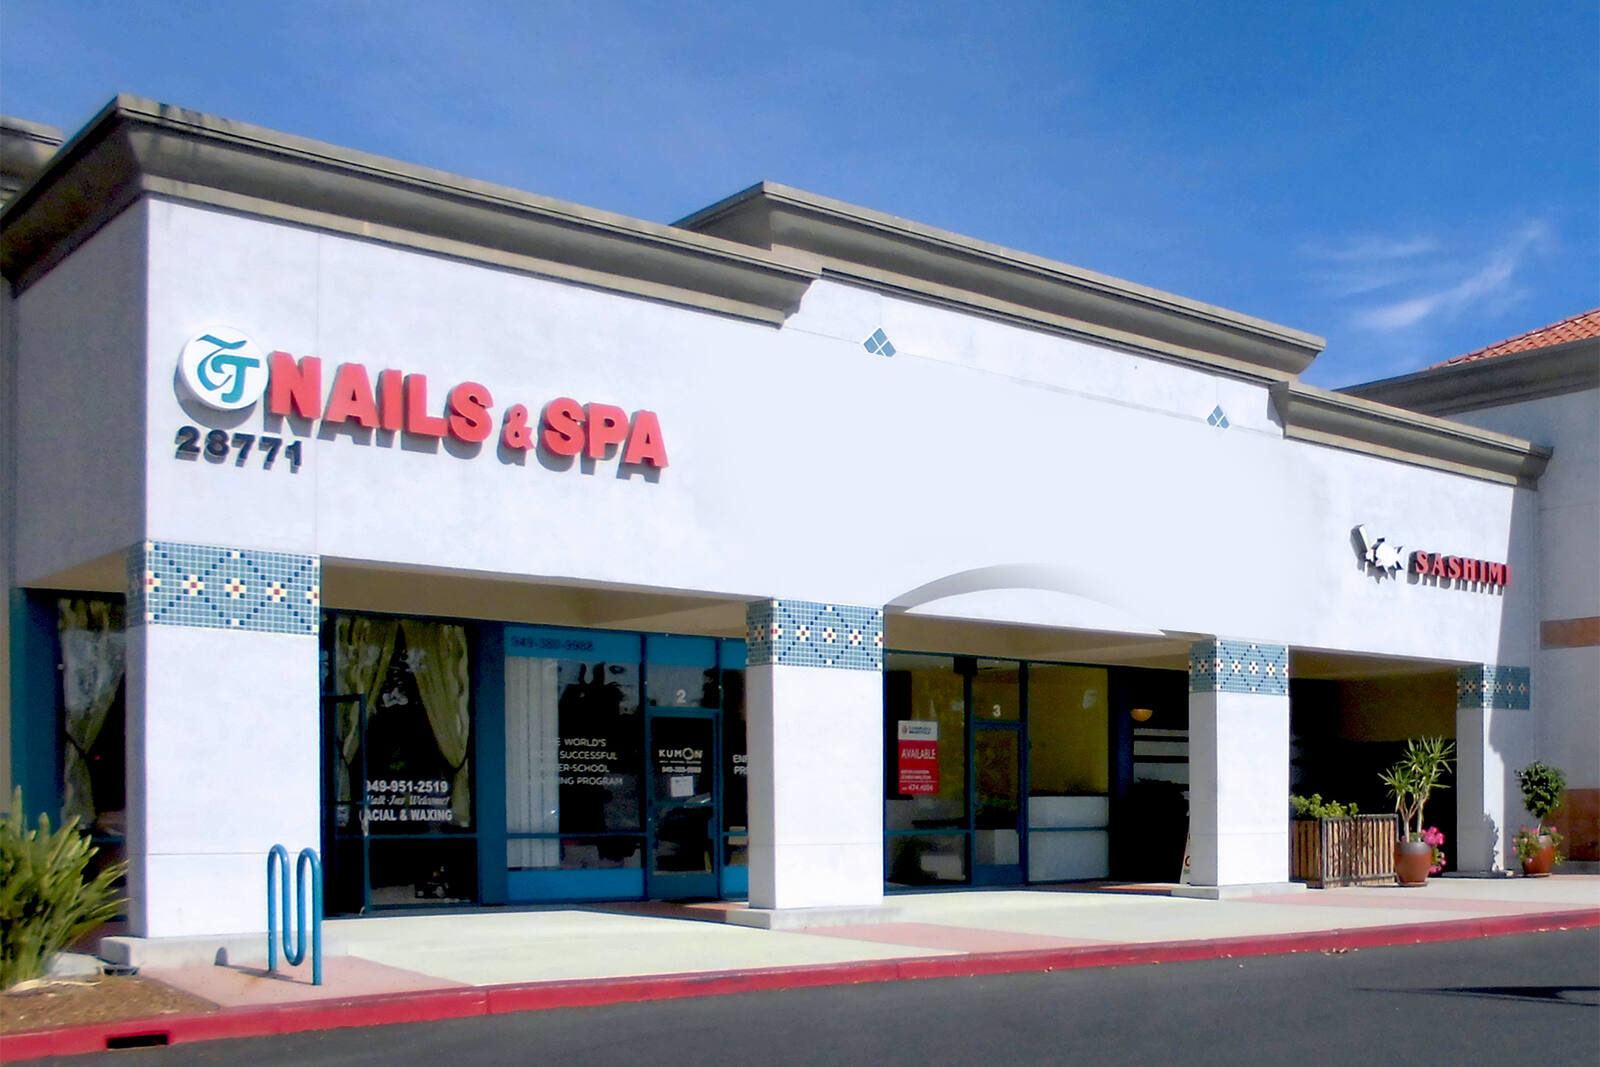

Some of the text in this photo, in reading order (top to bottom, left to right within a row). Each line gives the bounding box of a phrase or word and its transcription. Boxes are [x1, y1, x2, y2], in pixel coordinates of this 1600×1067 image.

[269, 350, 494, 443] NAILS
[502, 403, 534, 451] &
[543, 397, 669, 469] SPA
[174, 425, 303, 470] 28771
[1413, 550, 1512, 587] SASHIMI
[675, 689, 687, 704] 2
[992, 703, 1001, 717] 3
[560, 750, 618, 761] SUCCESSFUL
[658, 747, 704, 761] KUMON
[901, 748, 936, 760] AVAILABLE
[576, 776, 624, 787] PROGRAM
[410, 809, 453, 822] WAXING
